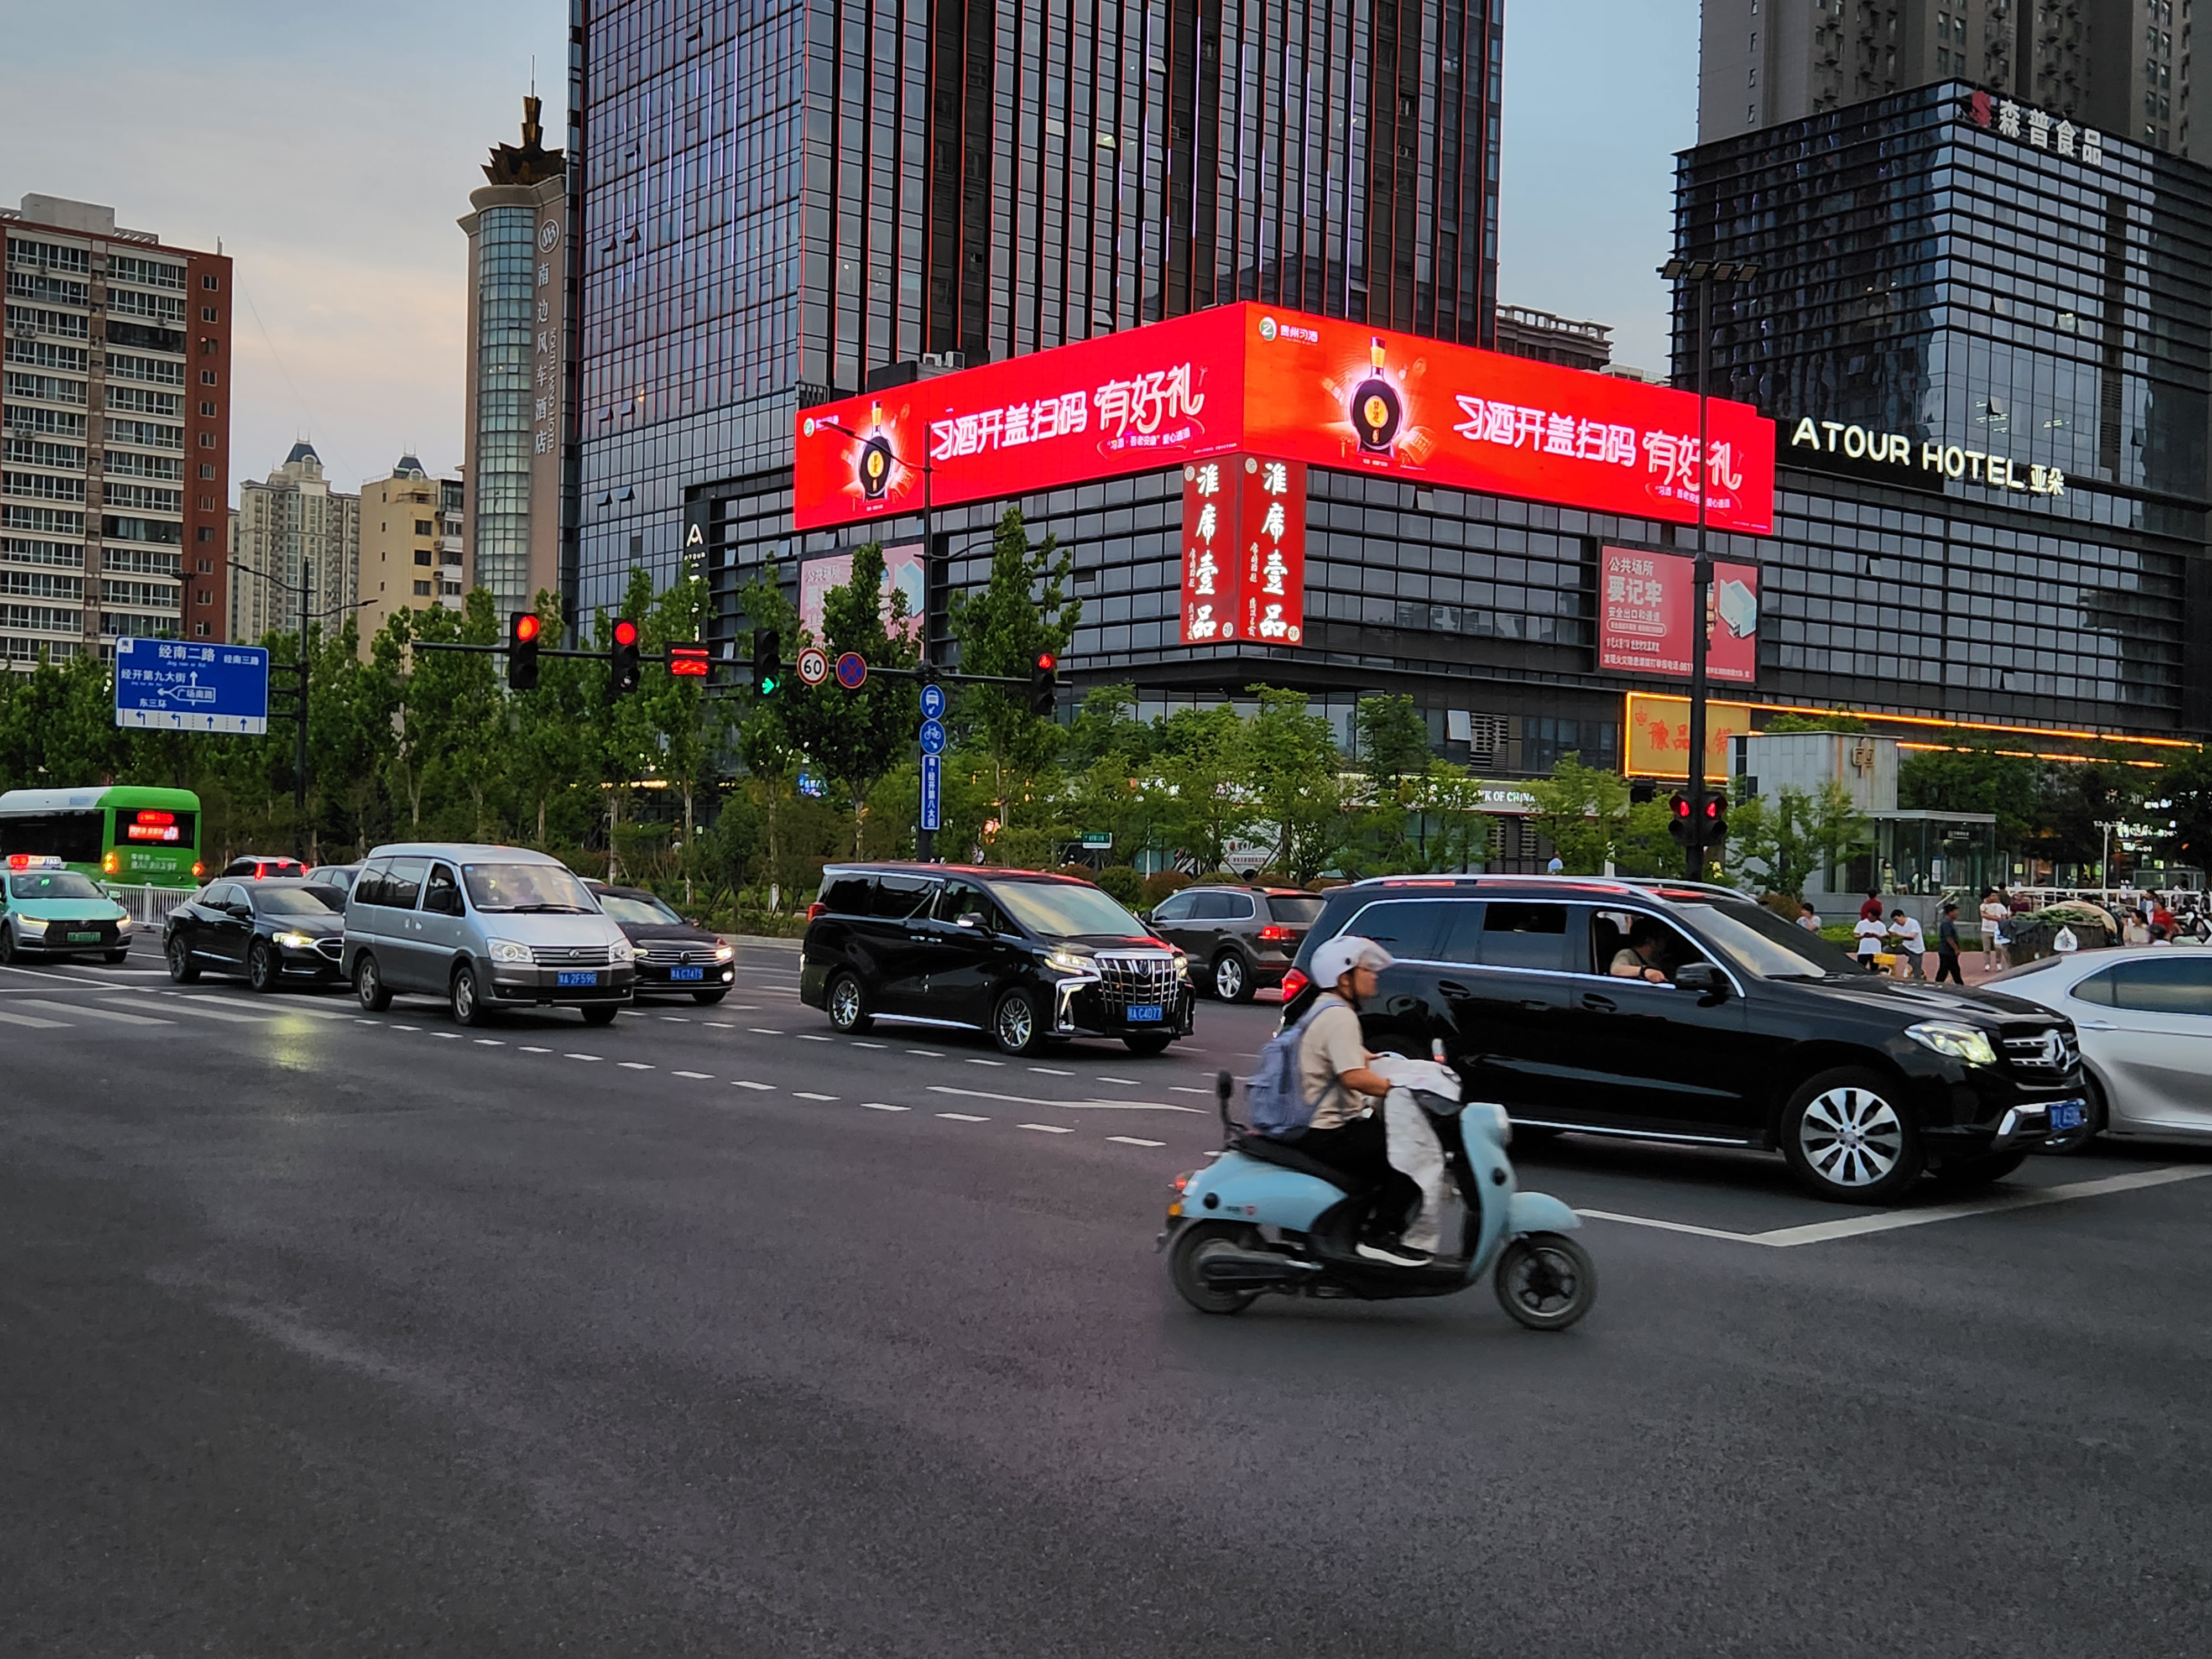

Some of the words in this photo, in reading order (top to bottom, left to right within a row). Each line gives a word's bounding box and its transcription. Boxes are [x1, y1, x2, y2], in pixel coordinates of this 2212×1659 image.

[930, 390, 1087, 461] 习酒开盖扫码
[1094, 362, 1205, 437] 有好礼
[1453, 394, 1636, 467] 习酒开盖扫码
[1642, 429, 1743, 492] 有好礼
[1792, 417, 1911, 466] ATOUR
[1922, 442, 2025, 489] HOTEL
[2030, 463, 2064, 496] 亚朵
[1192, 463, 1219, 639] 淮席壹品
[1260, 462, 1288, 638] 淮席壹品
[1608, 556, 1654, 576] 公共场所
[1606, 575, 1662, 607] 要记牢
[158, 644, 216, 662] 经南二路
[223, 654, 259, 666] 经南三路
[121, 669, 186, 684] 经开第九大街
[804, 660, 822, 675] 60
[139, 698, 168, 709] 东三环
[177, 688, 213, 700] 广场南路
[1493, 791, 1505, 802] OF
